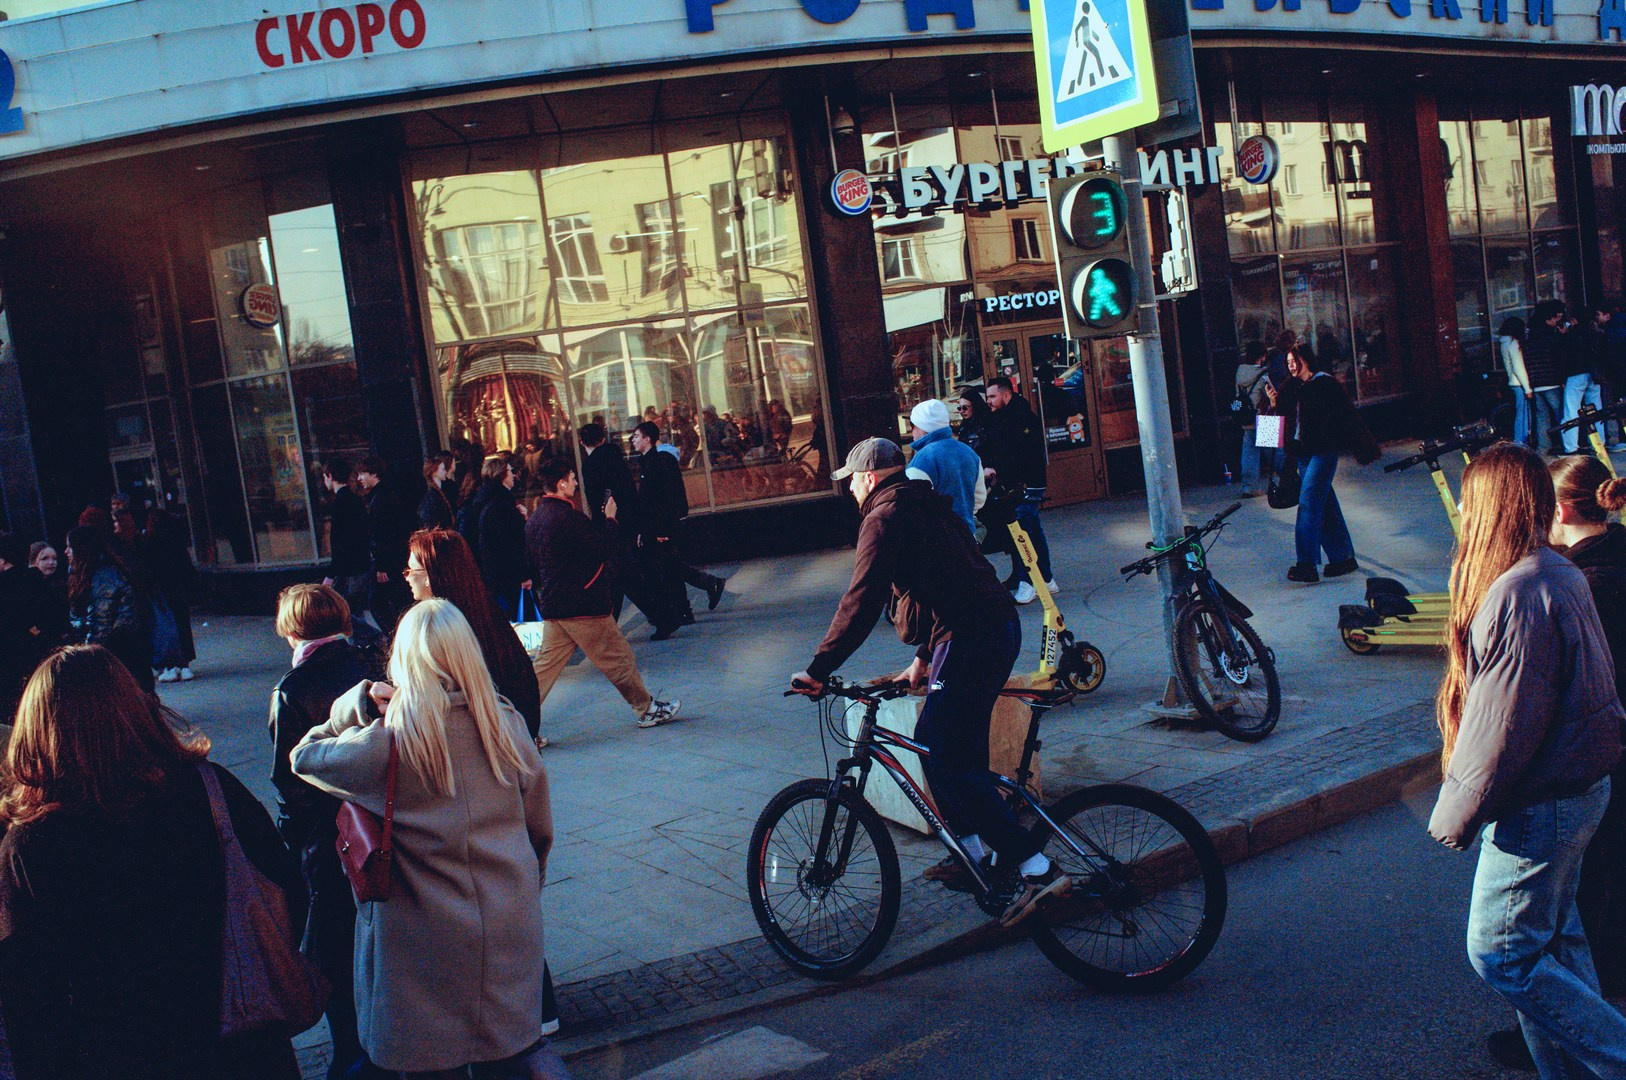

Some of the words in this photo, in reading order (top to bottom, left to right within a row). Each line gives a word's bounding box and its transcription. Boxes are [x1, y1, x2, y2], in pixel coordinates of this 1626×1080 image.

[255, 0, 427, 68] СКОРО
[1137, 146, 1224, 186] ИНГ
[1242, 151, 1265, 174] KING
[837, 177, 866, 195] BURGER
[840, 184, 868, 205] KING
[1090, 191, 1117, 237] 3
[985, 290, 1060, 312] РЕСТОР
[1046, 629, 1058, 666] 127452
[900, 780, 943, 832] mongoose
